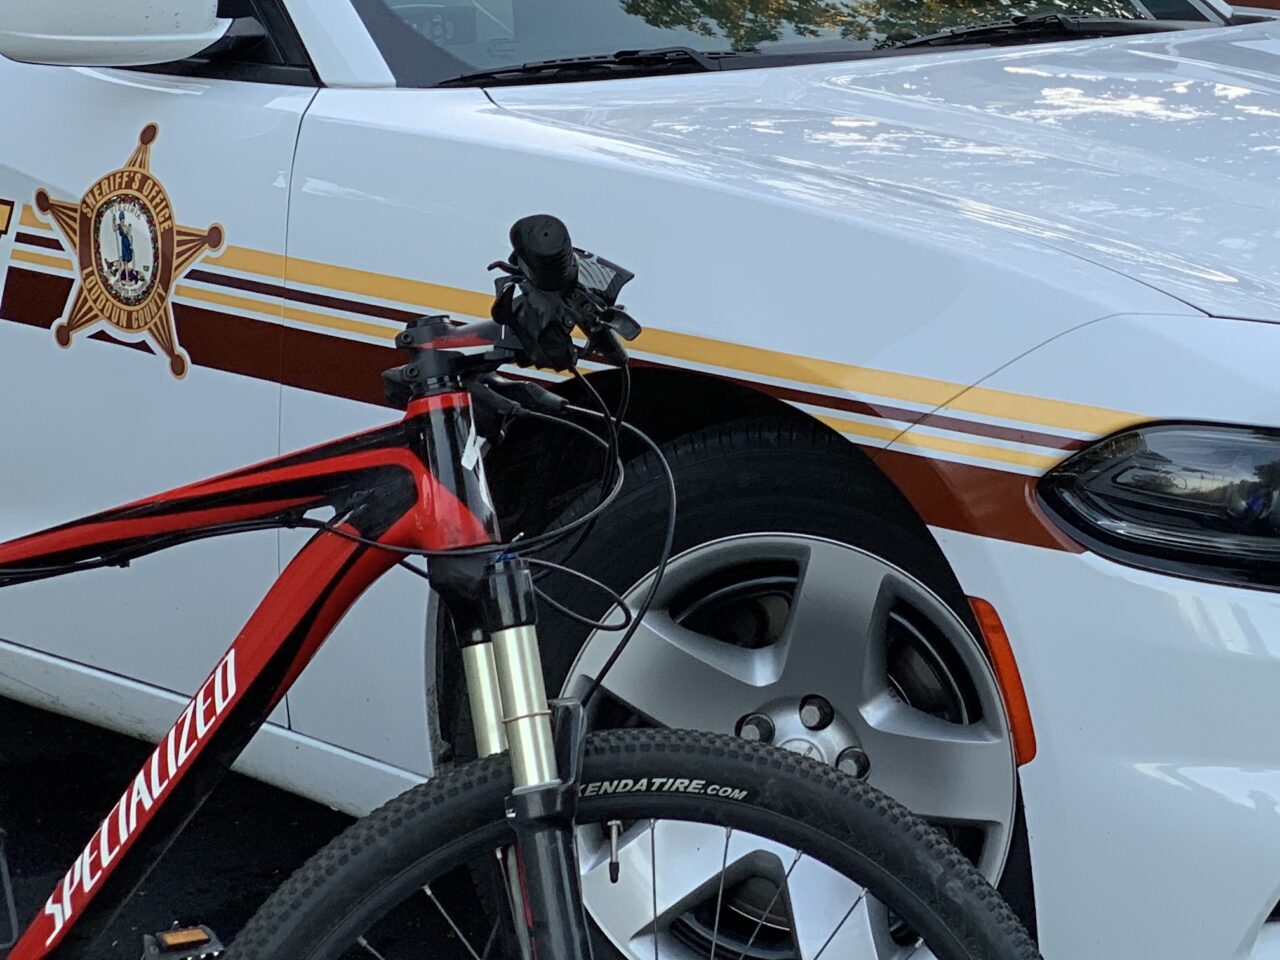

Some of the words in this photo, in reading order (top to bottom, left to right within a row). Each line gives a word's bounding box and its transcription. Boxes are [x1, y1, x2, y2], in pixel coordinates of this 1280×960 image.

[82, 171, 142, 219] SHERIFF'S
[142, 178, 172, 233] OFFICE
[81, 265, 129, 328] LOUDOUN
[131, 284, 167, 329] COUNTY
[45, 648, 237, 948] SPECIALIZED
